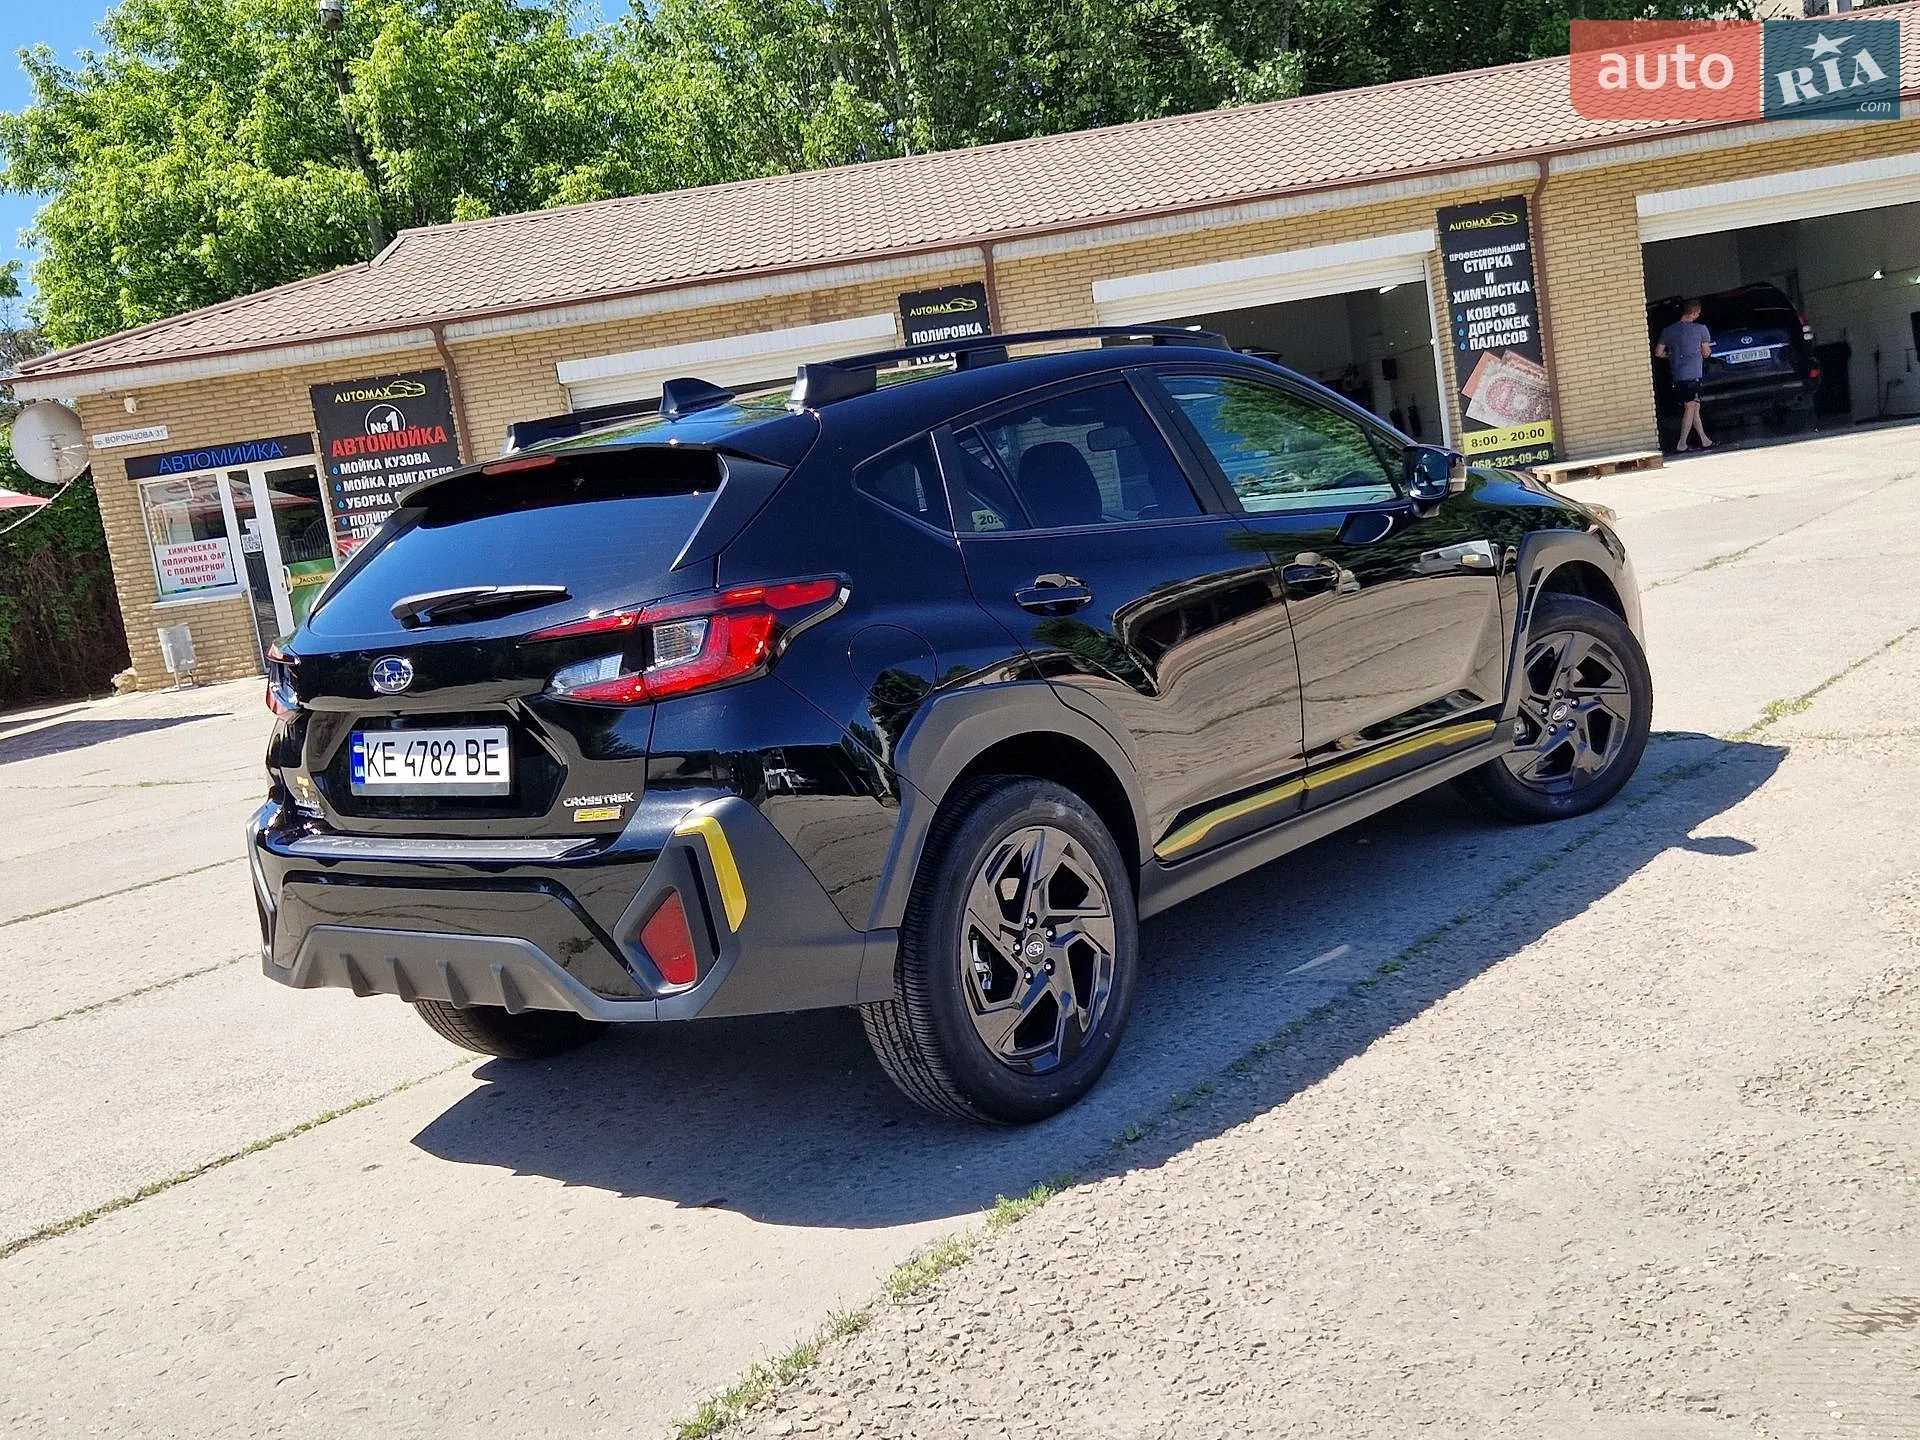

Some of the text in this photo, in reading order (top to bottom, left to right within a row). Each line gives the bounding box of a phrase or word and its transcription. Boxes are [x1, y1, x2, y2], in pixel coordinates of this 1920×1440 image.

[1449, 217, 1492, 231] AUTOMAX
[1449, 243, 1526, 262] ПРОФЕССИОНАЛЬНАЯ
[1463, 254, 1513, 273] СТИРКА
[1484, 271, 1495, 285] И
[1452, 280, 1530, 304] ХИМЧИСТКА
[909, 303, 952, 317] AUTOMAX
[1466, 302, 1517, 322] КОВРОВ
[911, 322, 983, 345] ПОЛИРОВКА
[1468, 314, 1530, 339] ДОРОЖЕК
[1469, 330, 1528, 351] ПАЛАСОВ
[334, 387, 392, 404] AUTOMAX
[331, 425, 448, 457] АВТОМОЙКА
[1471, 435, 1498, 448] 8:00
[1510, 428, 1545, 442] 20:00
[159, 441, 284, 474] АВТОМИЙКА
[340, 452, 431, 475] МОЙКА КУЗОВА
[1472, 449, 1549, 469] 068-323-09-49
[343, 474, 386, 492] МОЙКА
[346, 491, 393, 509] УБОРКА
[162, 551, 227, 567] ПОЛИРОВКА ФАР
[168, 543, 217, 556] ХИМИЧЕСКАЯ
[167, 569, 173, 577] С
[366, 739, 500, 777] KE 4782 BE
[354, 766, 365, 778] UA
[563, 792, 636, 807] CROSSTREK
